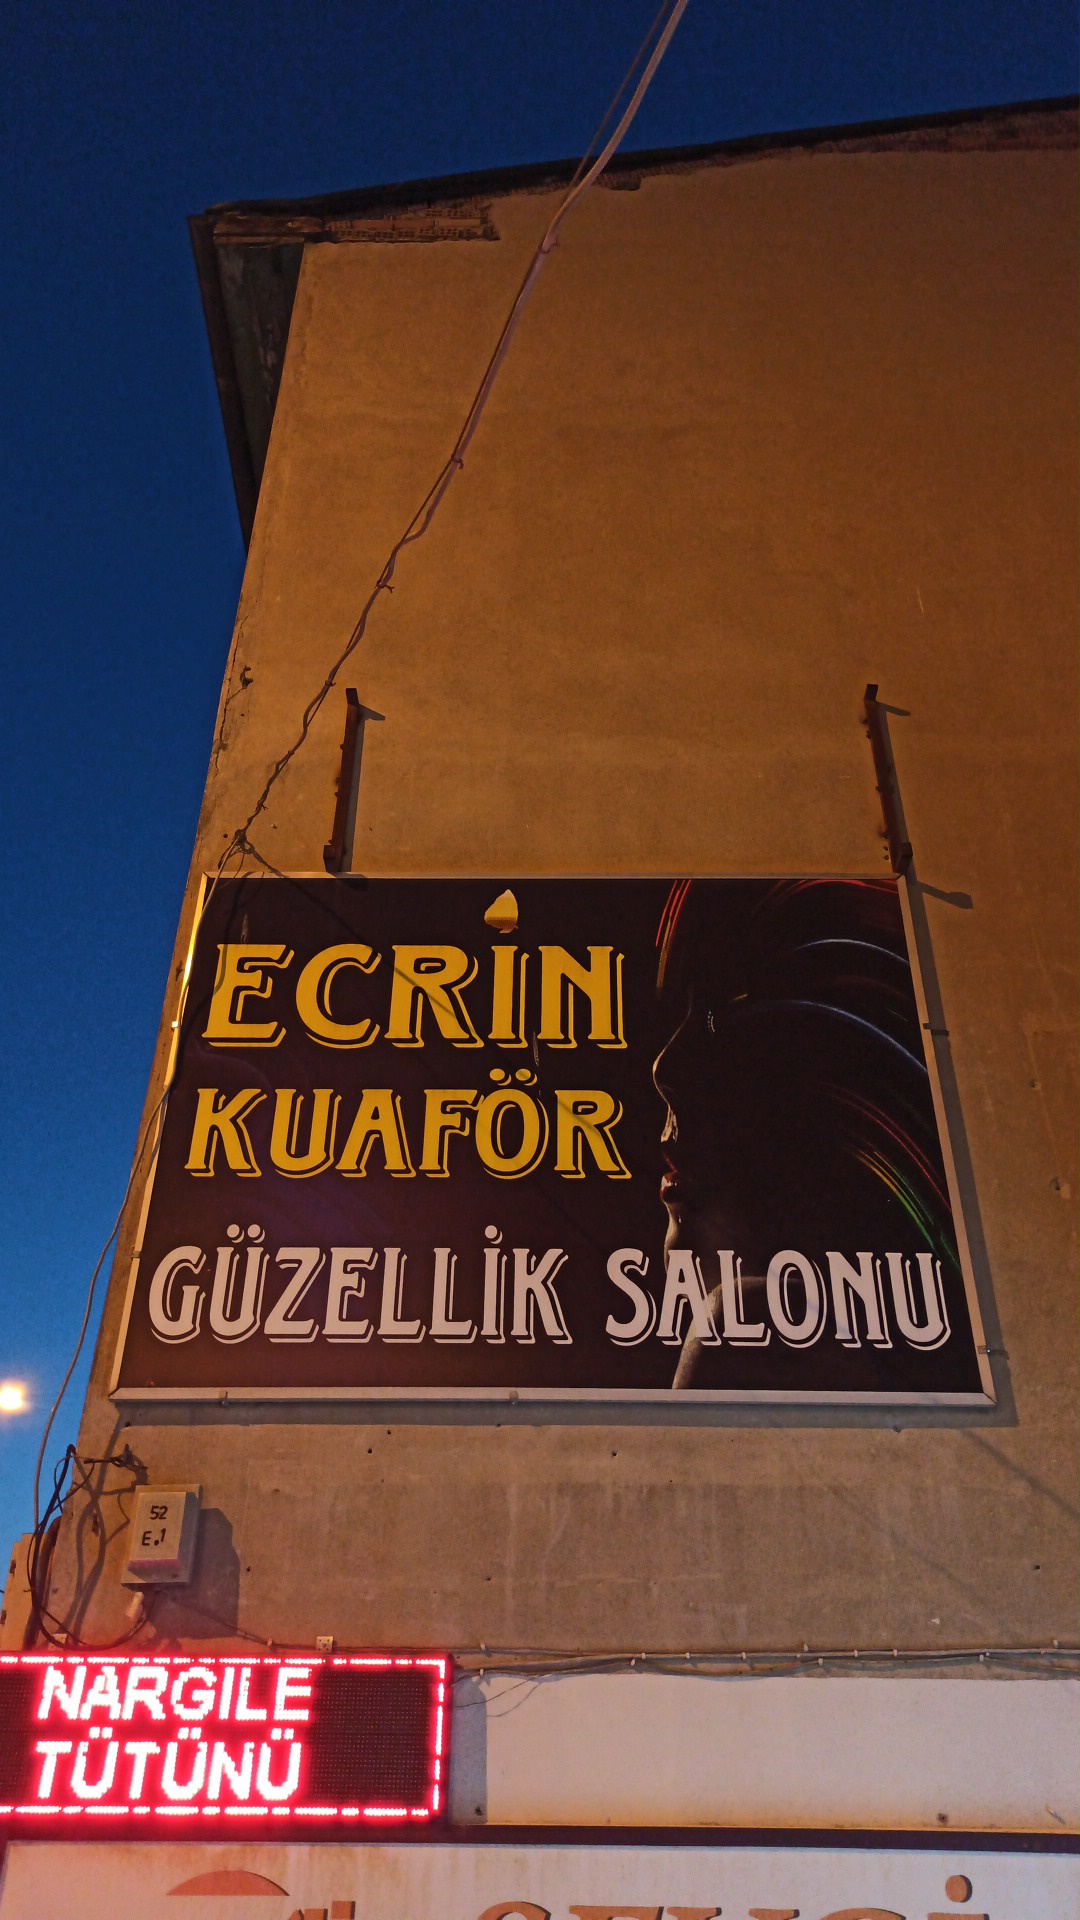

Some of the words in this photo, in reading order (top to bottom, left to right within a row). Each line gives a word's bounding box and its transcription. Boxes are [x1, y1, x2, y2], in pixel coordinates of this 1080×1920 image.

[201, 888, 628, 1050] ECRİN
[184, 1067, 633, 1181] KUAFÖR
[147, 1223, 574, 1346] GÜZELLİK
[604, 1247, 953, 1350] SALONU
[149, 1505, 169, 1520] 52
[34, 1727, 303, 1801] TÜTÜNÜ
